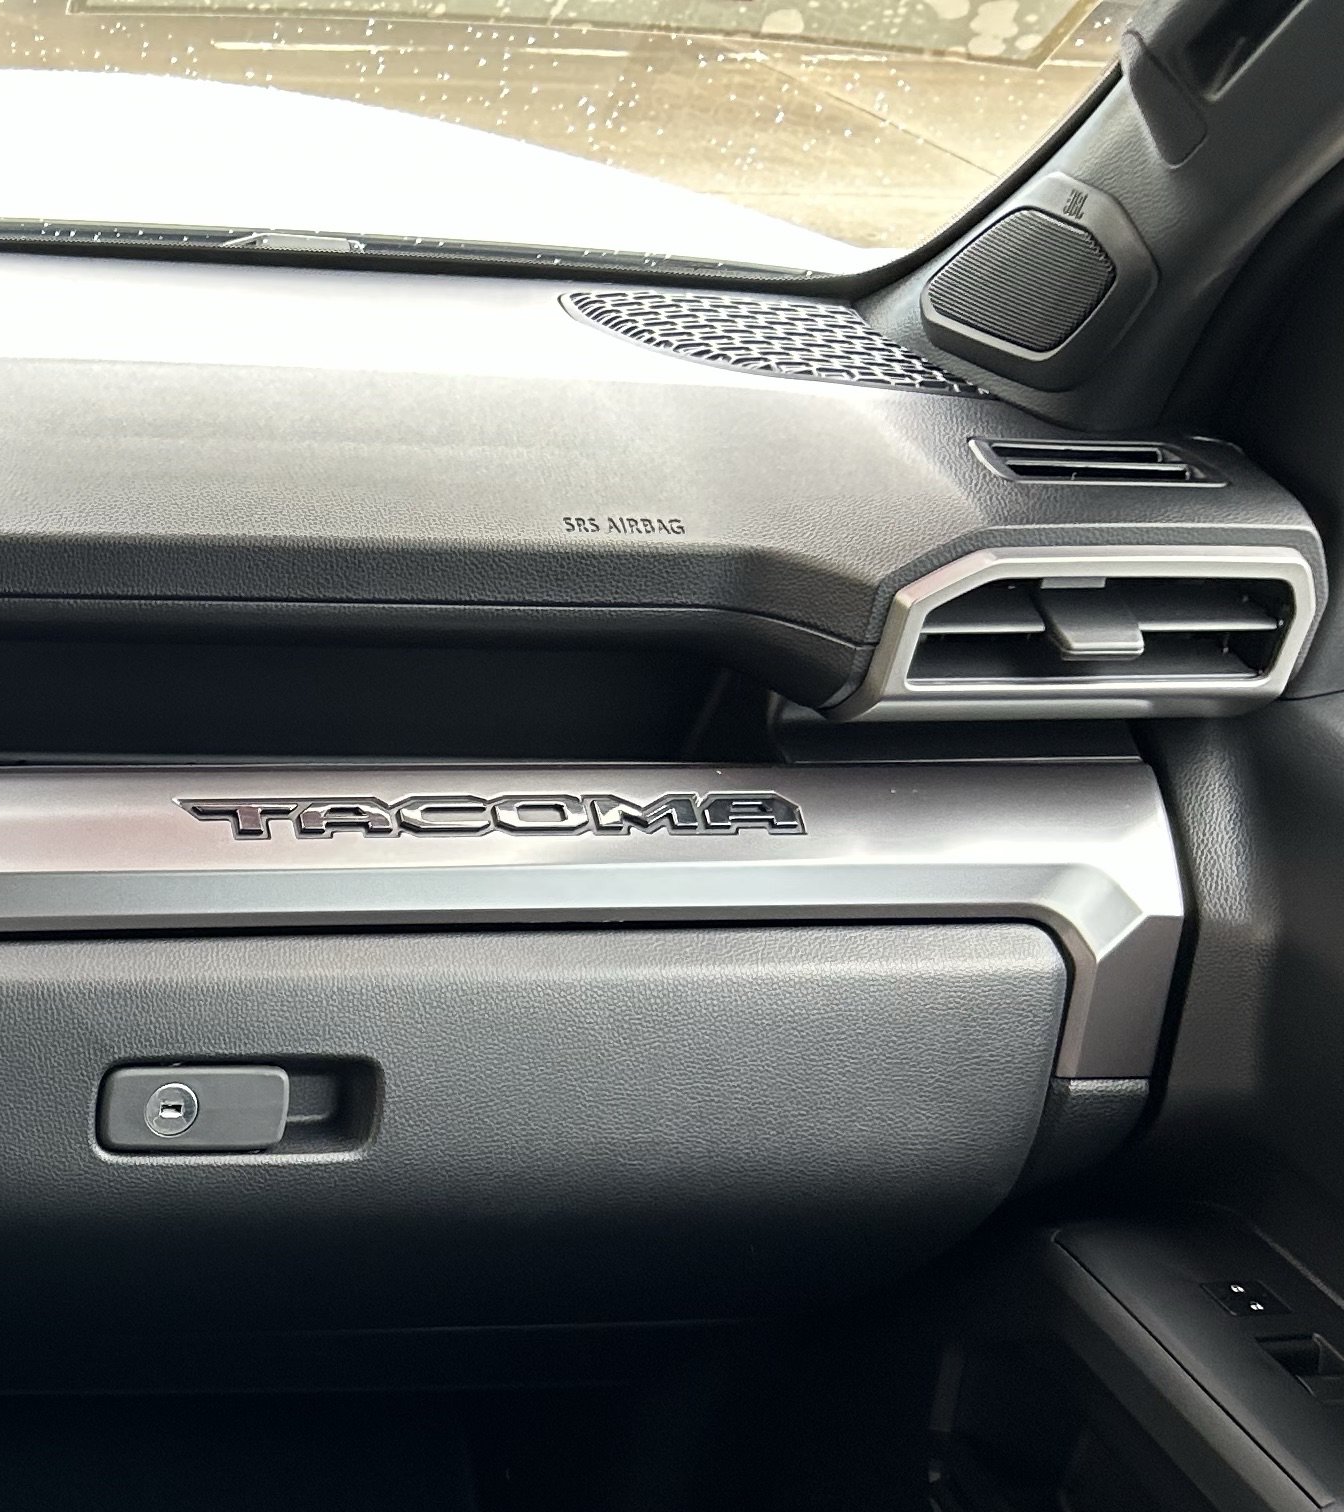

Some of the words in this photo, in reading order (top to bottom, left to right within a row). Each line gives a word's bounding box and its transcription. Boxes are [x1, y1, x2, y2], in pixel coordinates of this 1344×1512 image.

[562, 516, 600, 533] SRS
[607, 516, 686, 535] AIRBAG
[172, 790, 807, 839] TACOMA
